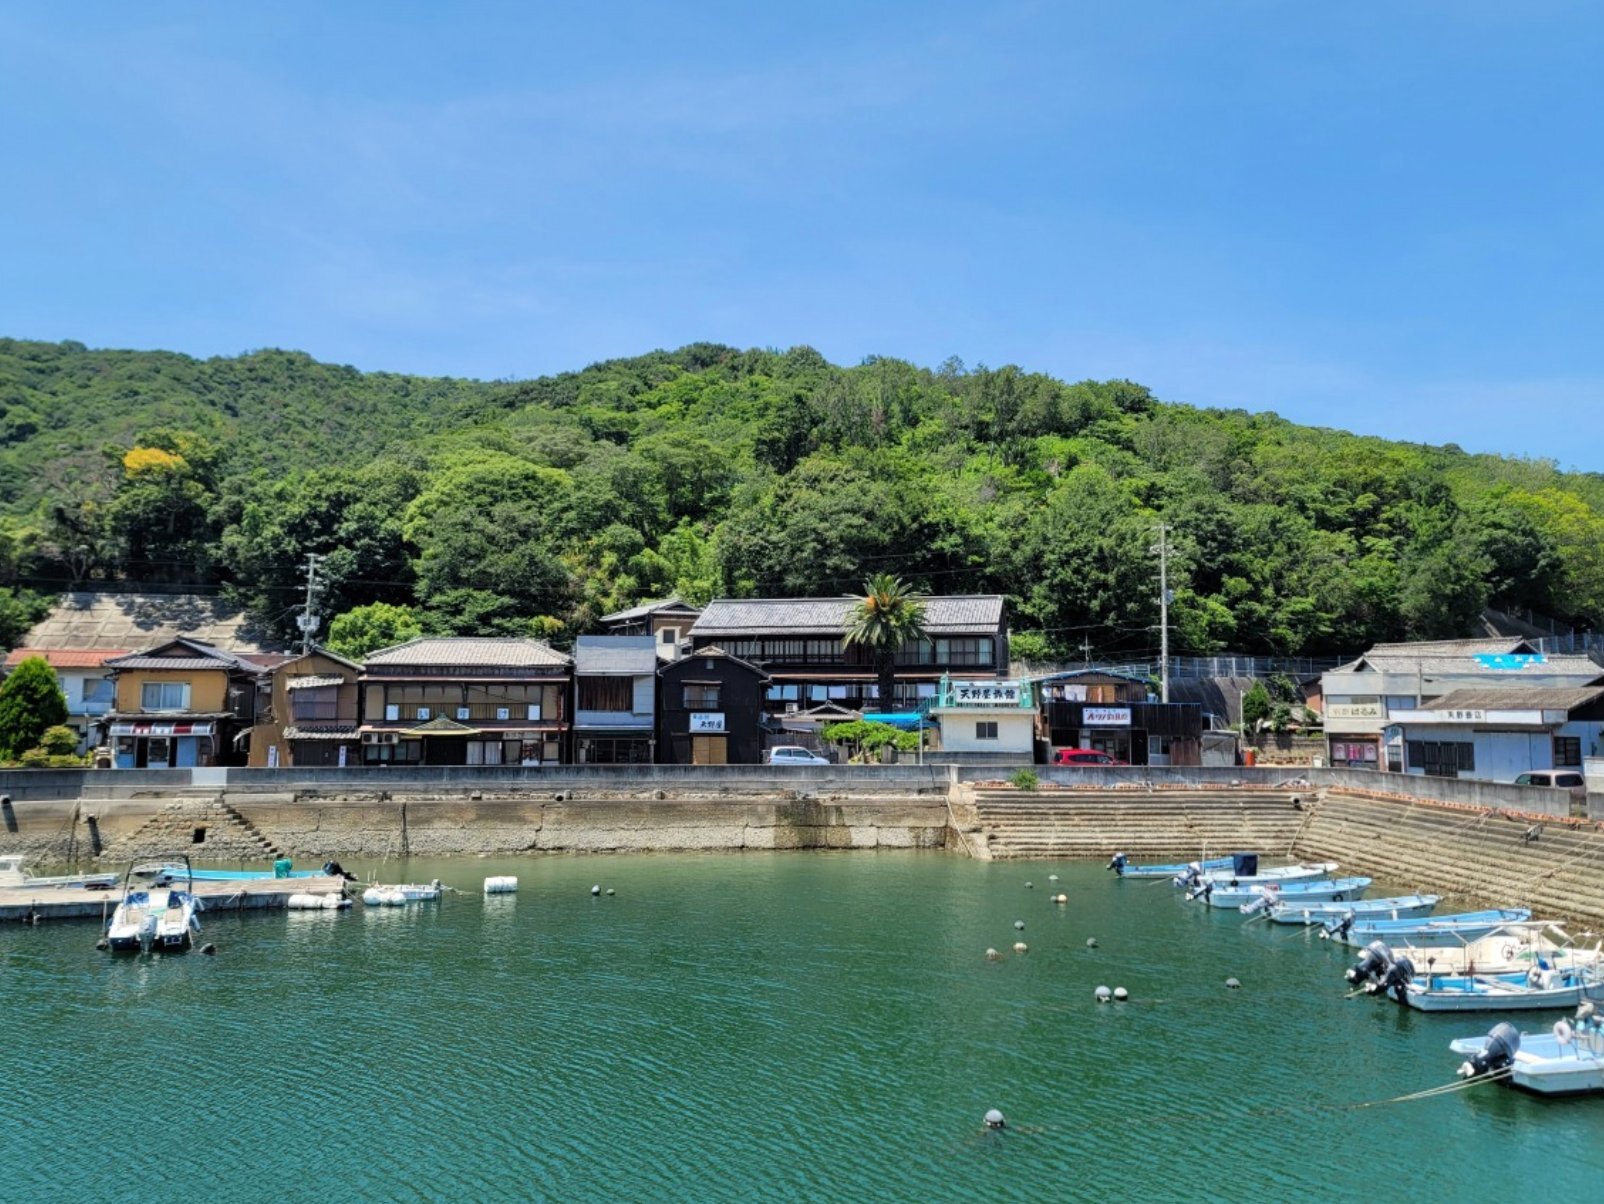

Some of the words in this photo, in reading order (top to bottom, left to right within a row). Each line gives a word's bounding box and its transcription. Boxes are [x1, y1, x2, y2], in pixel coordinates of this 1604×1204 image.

[960, 688, 1016, 699] 天野屋旅館
